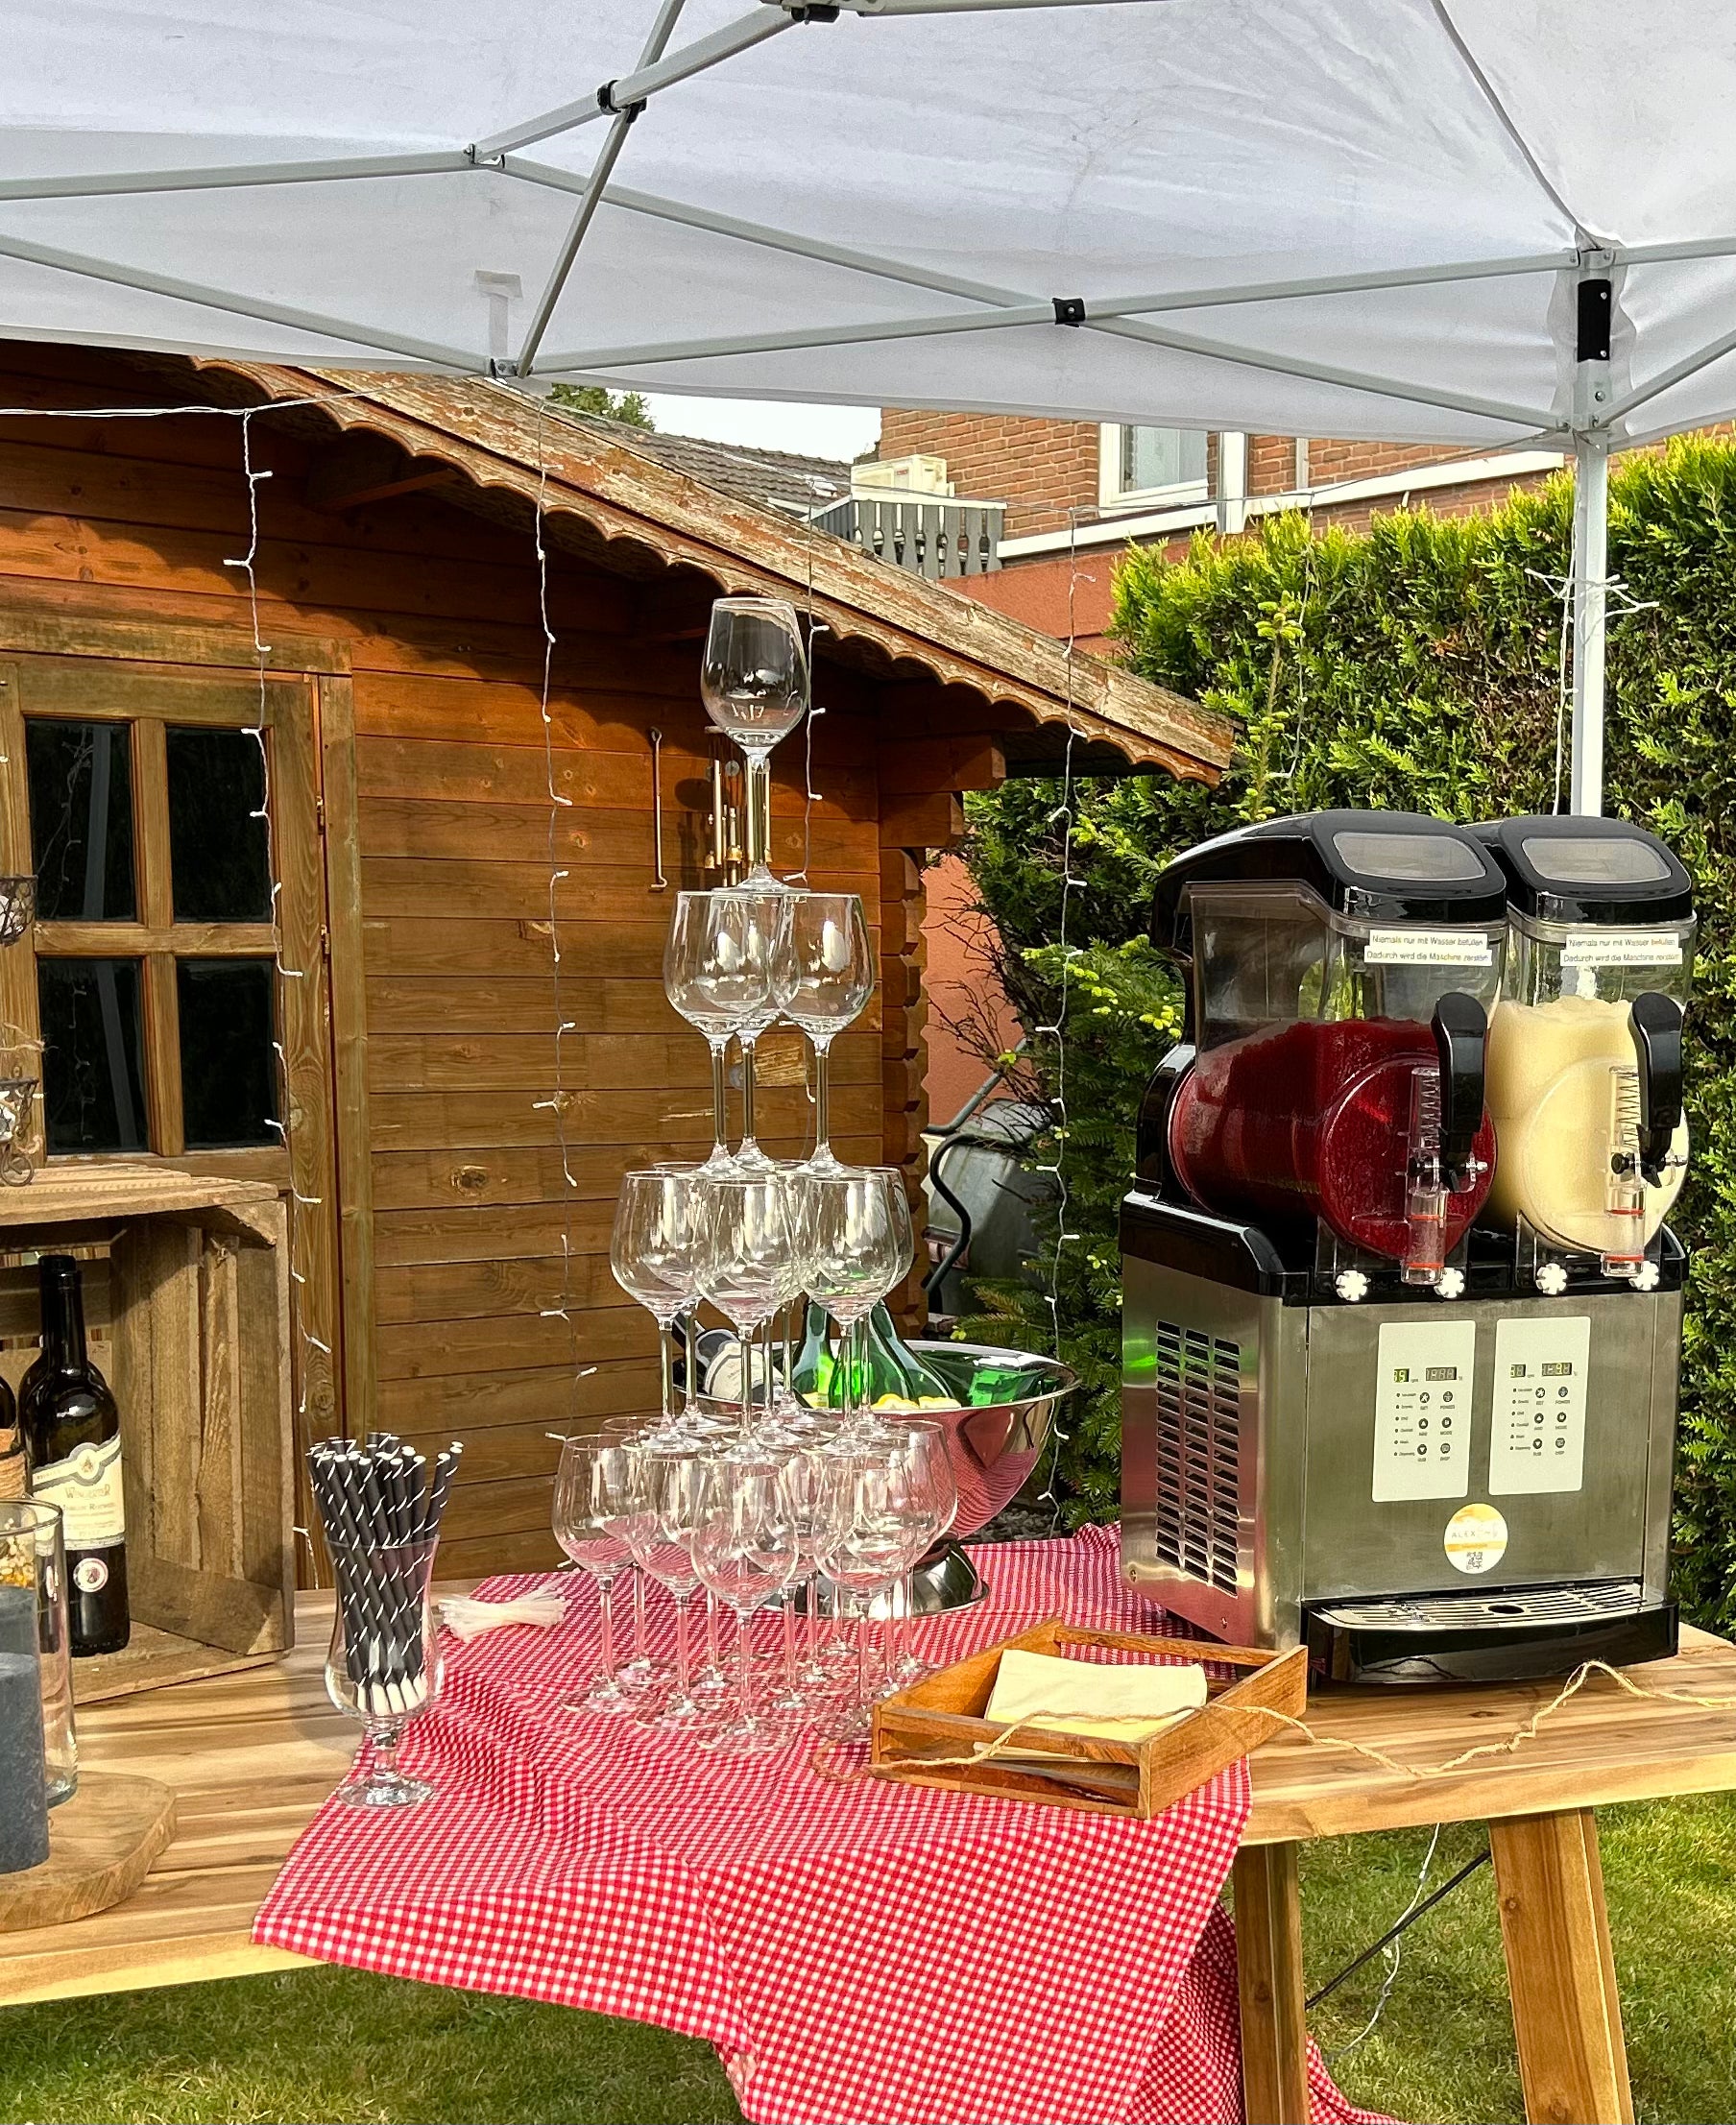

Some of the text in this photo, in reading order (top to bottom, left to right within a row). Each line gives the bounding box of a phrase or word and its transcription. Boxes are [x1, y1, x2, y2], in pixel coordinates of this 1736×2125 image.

[1430, 936, 1456, 946] Wasser
[1625, 938, 1650, 947] Wasser
[1366, 950, 1398, 959] Dadurch
[1429, 953, 1461, 961] Maschine
[1563, 954, 1593, 962] Dadurch
[1595, 954, 1610, 962] wird
[1610, 954, 1622, 962] die
[1623, 953, 1654, 961] Maschine
